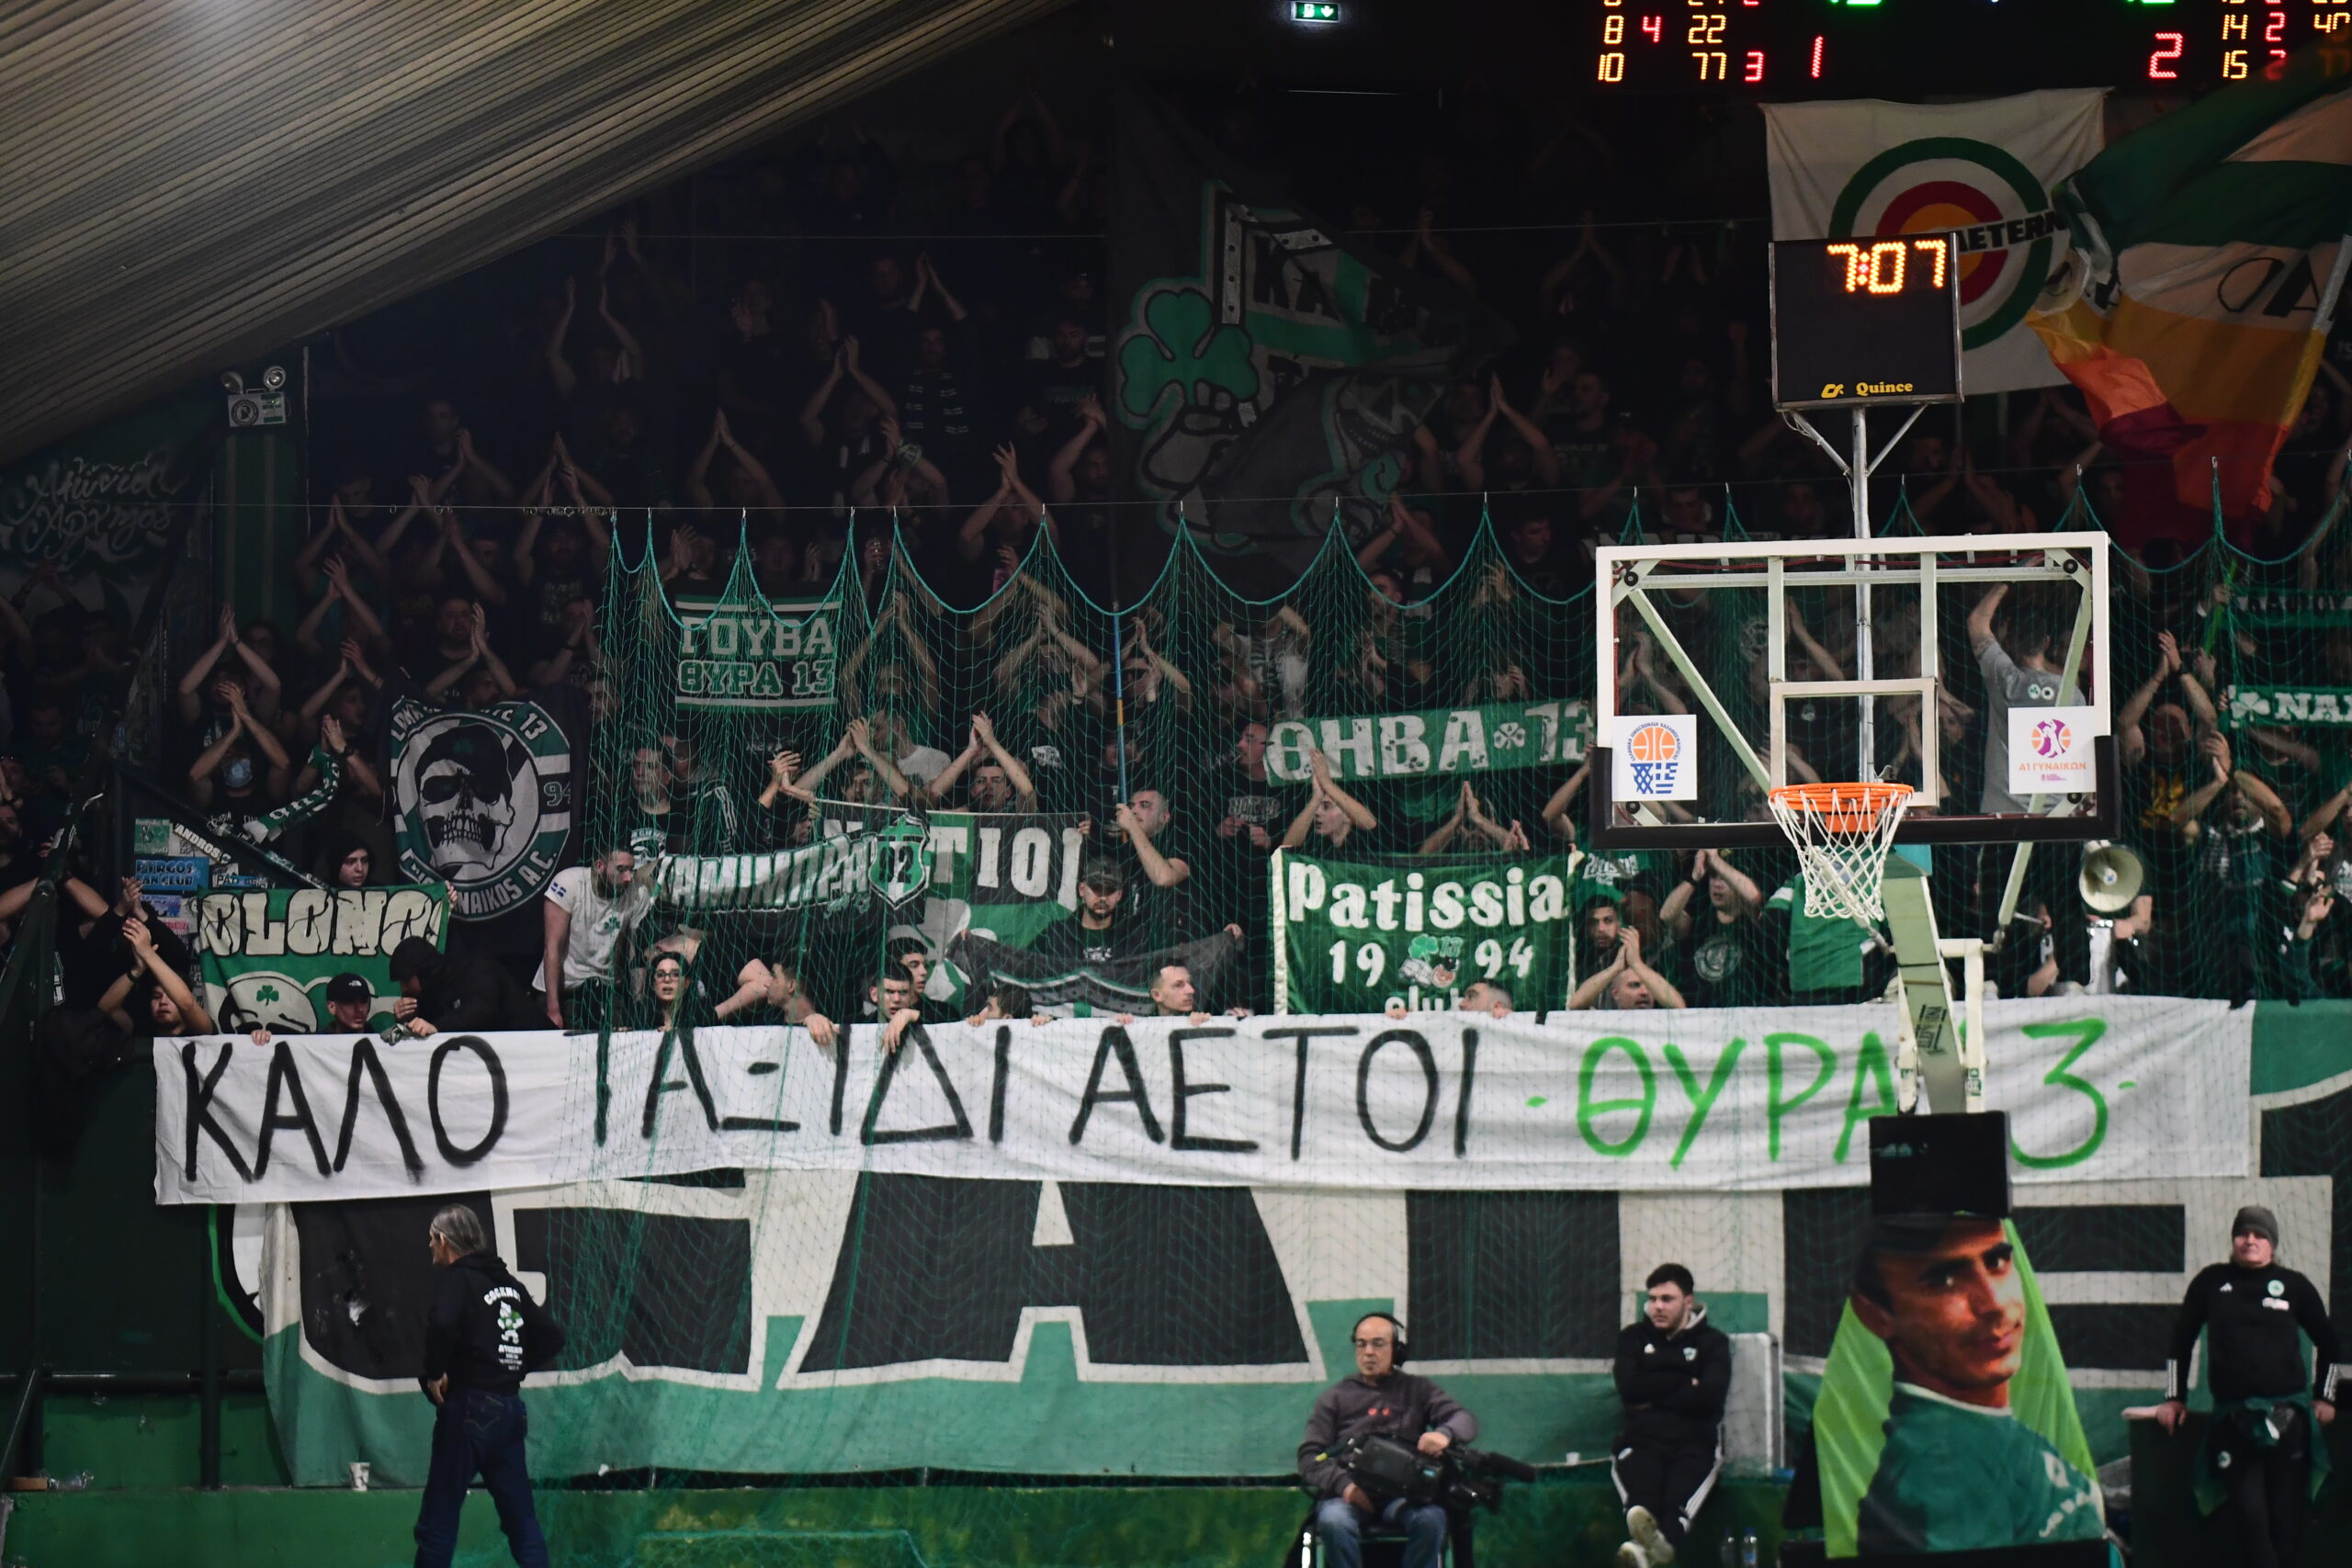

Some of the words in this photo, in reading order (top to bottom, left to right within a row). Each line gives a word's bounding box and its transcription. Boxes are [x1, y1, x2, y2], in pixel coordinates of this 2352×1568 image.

[1604, 15, 1624, 44] 8
[1643, 16, 1661, 43] 4
[1688, 15, 1726, 43] 22
[2222, 14, 2248, 39] 14
[2266, 12, 2286, 41] 2
[1598, 52, 1624, 82] 10
[1692, 52, 1726, 80] 77
[1745, 51, 1764, 81] 3
[2149, 33, 2183, 78] 2
[2222, 50, 2248, 79] 15
[1826, 239, 1947, 293] 7:07
[1856, 381, 1915, 397] Quince
[682, 616, 834, 656] ΓΟΥΒΑ
[679, 660, 784, 696] ΘΥΡΑ
[792, 660, 835, 696] 13
[518, 713, 548, 741] 13
[1266, 710, 1488, 781] ΘΗΒΑ
[1288, 862, 1569, 932] Patissia
[1329, 939, 1385, 987] 19
[1475, 935, 1534, 979] 94
[182, 1033, 510, 1185] ΚΑΛΟ
[1069, 1025, 1479, 1161] ΑΕΤΟΙ
[1577, 1030, 1896, 1171] ΘΥΡΑ
